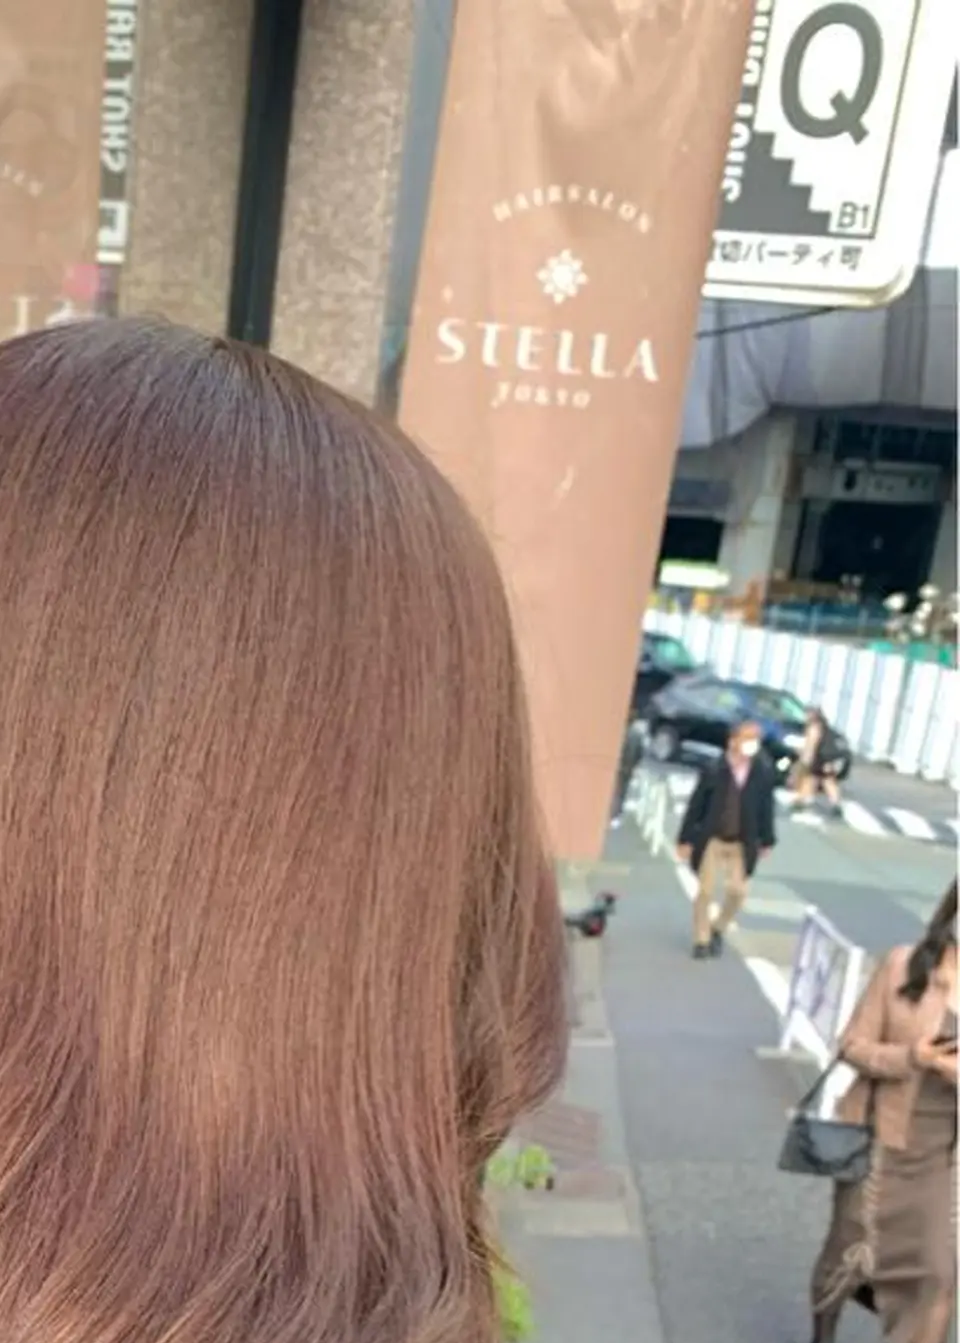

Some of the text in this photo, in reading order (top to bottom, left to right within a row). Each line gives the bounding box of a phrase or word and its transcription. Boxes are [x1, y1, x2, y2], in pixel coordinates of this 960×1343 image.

[780, 2, 883, 146] Q
[837, 203, 872, 230] B1
[711, 239, 863, 271] 切パーティ可
[437, 317, 660, 382] STELLA
